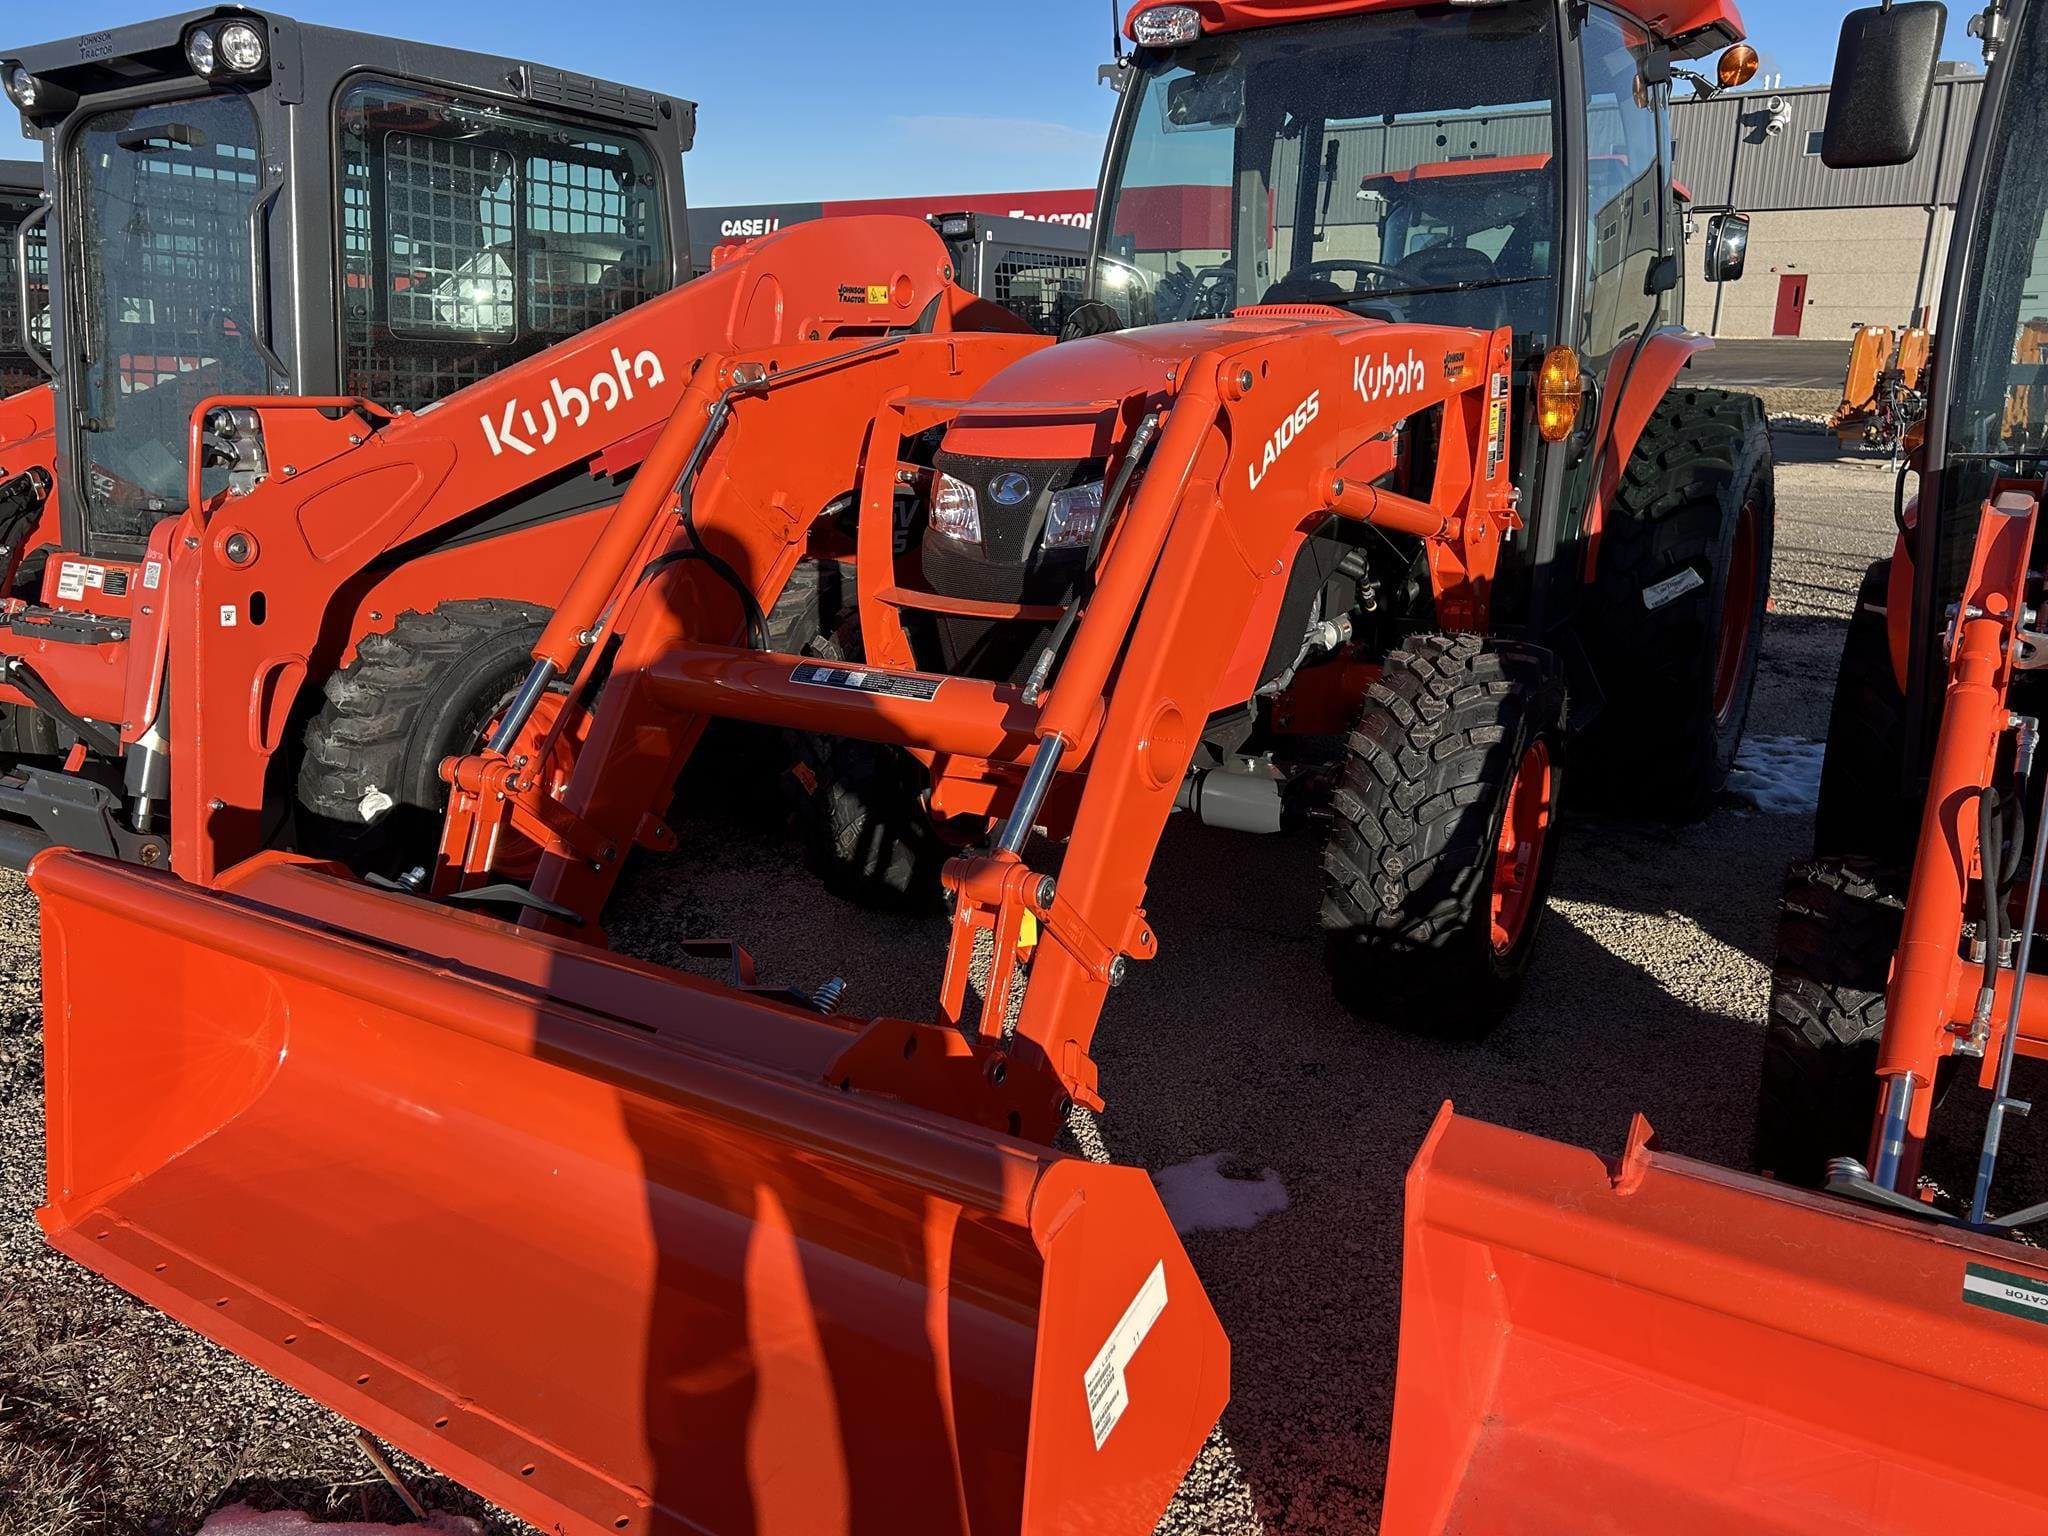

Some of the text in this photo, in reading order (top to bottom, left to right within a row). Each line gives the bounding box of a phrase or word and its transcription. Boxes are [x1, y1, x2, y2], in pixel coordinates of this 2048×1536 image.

[79, 33, 112, 47] JOHNSON
[80, 45, 112, 60] TRACTOR
[721, 219, 763, 236] CASE
[1353, 348, 1424, 402] Kubota
[480, 347, 665, 456] Kubota
[1249, 389, 1319, 491] LA1065
